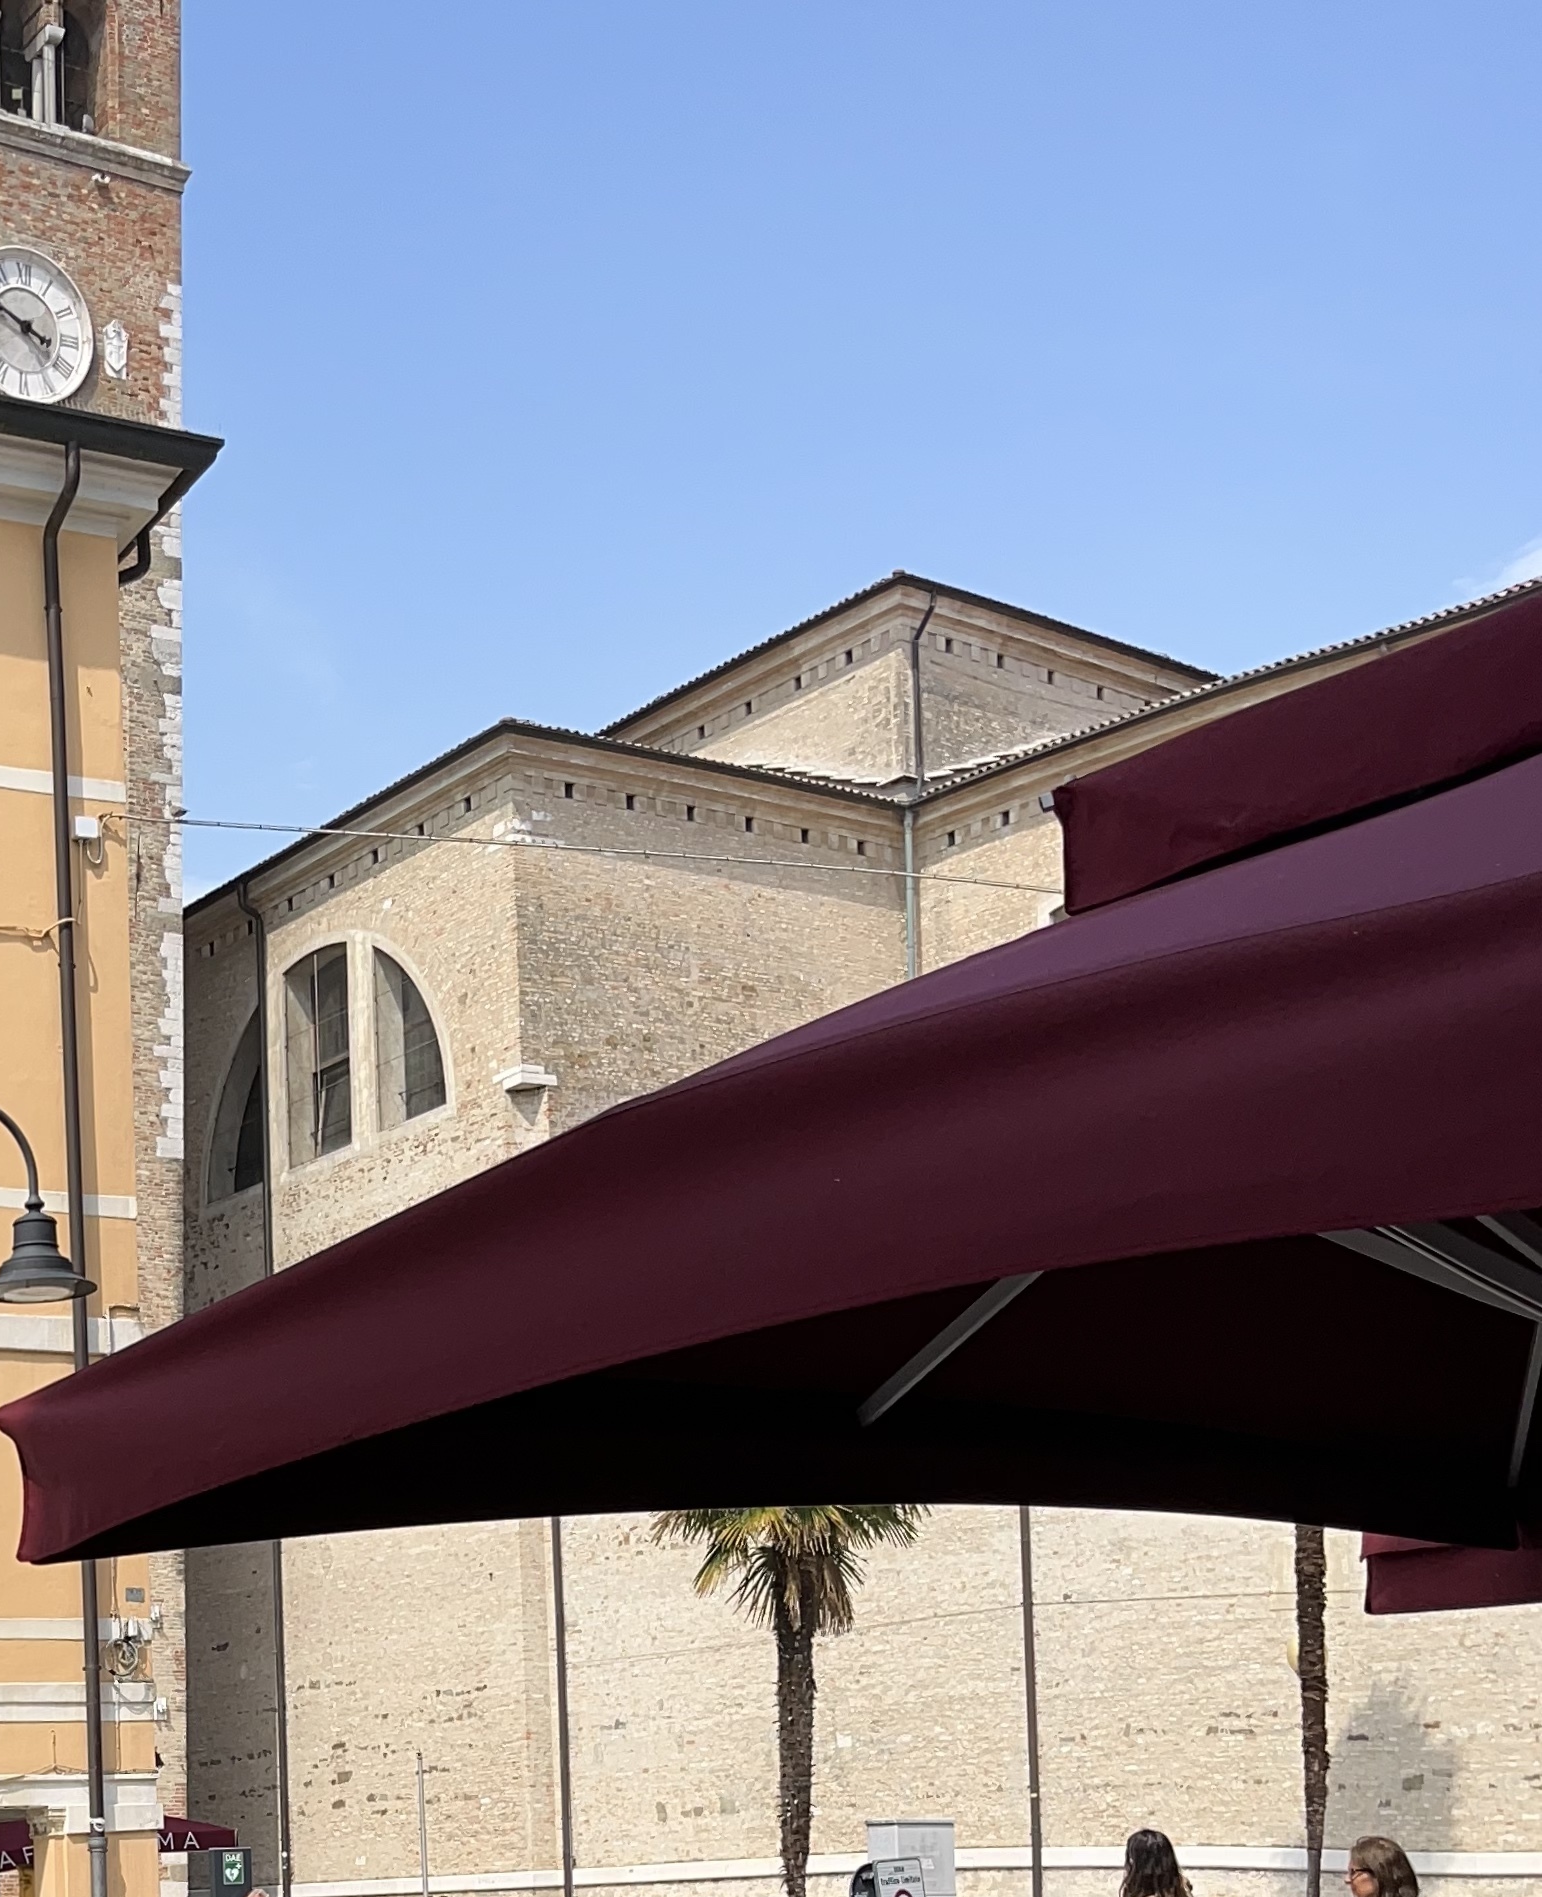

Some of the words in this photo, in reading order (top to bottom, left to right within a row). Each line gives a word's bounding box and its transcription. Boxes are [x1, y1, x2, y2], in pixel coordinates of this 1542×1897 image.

[16, 262, 32, 287] XII
[60, 333, 79, 351] III
[225, 1853, 242, 1862] DAE
